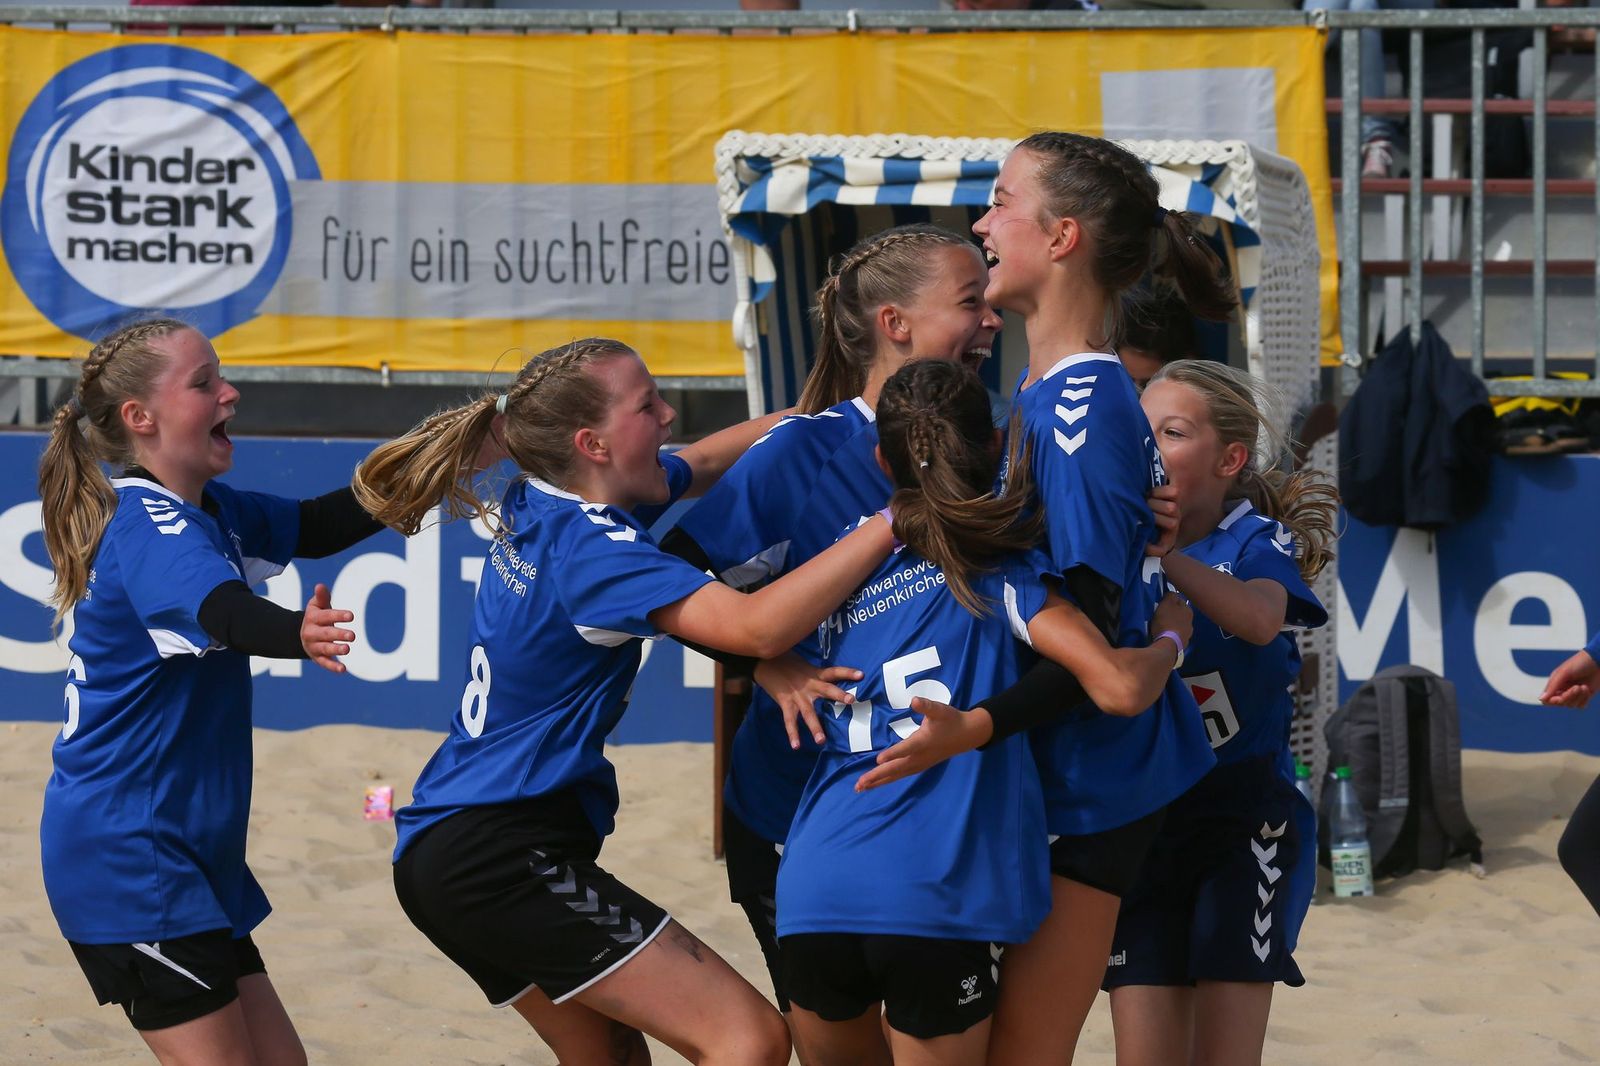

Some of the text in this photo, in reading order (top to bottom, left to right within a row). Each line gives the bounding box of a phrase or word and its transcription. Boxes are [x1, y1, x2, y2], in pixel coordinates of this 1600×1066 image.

[68, 143, 256, 185] Kinder
[66, 186, 255, 229] stark
[67, 232, 253, 265] machen
[322, 215, 730, 285] für ein suchtfreie
[461, 645, 492, 739] 8
[828, 645, 952, 753] 15
